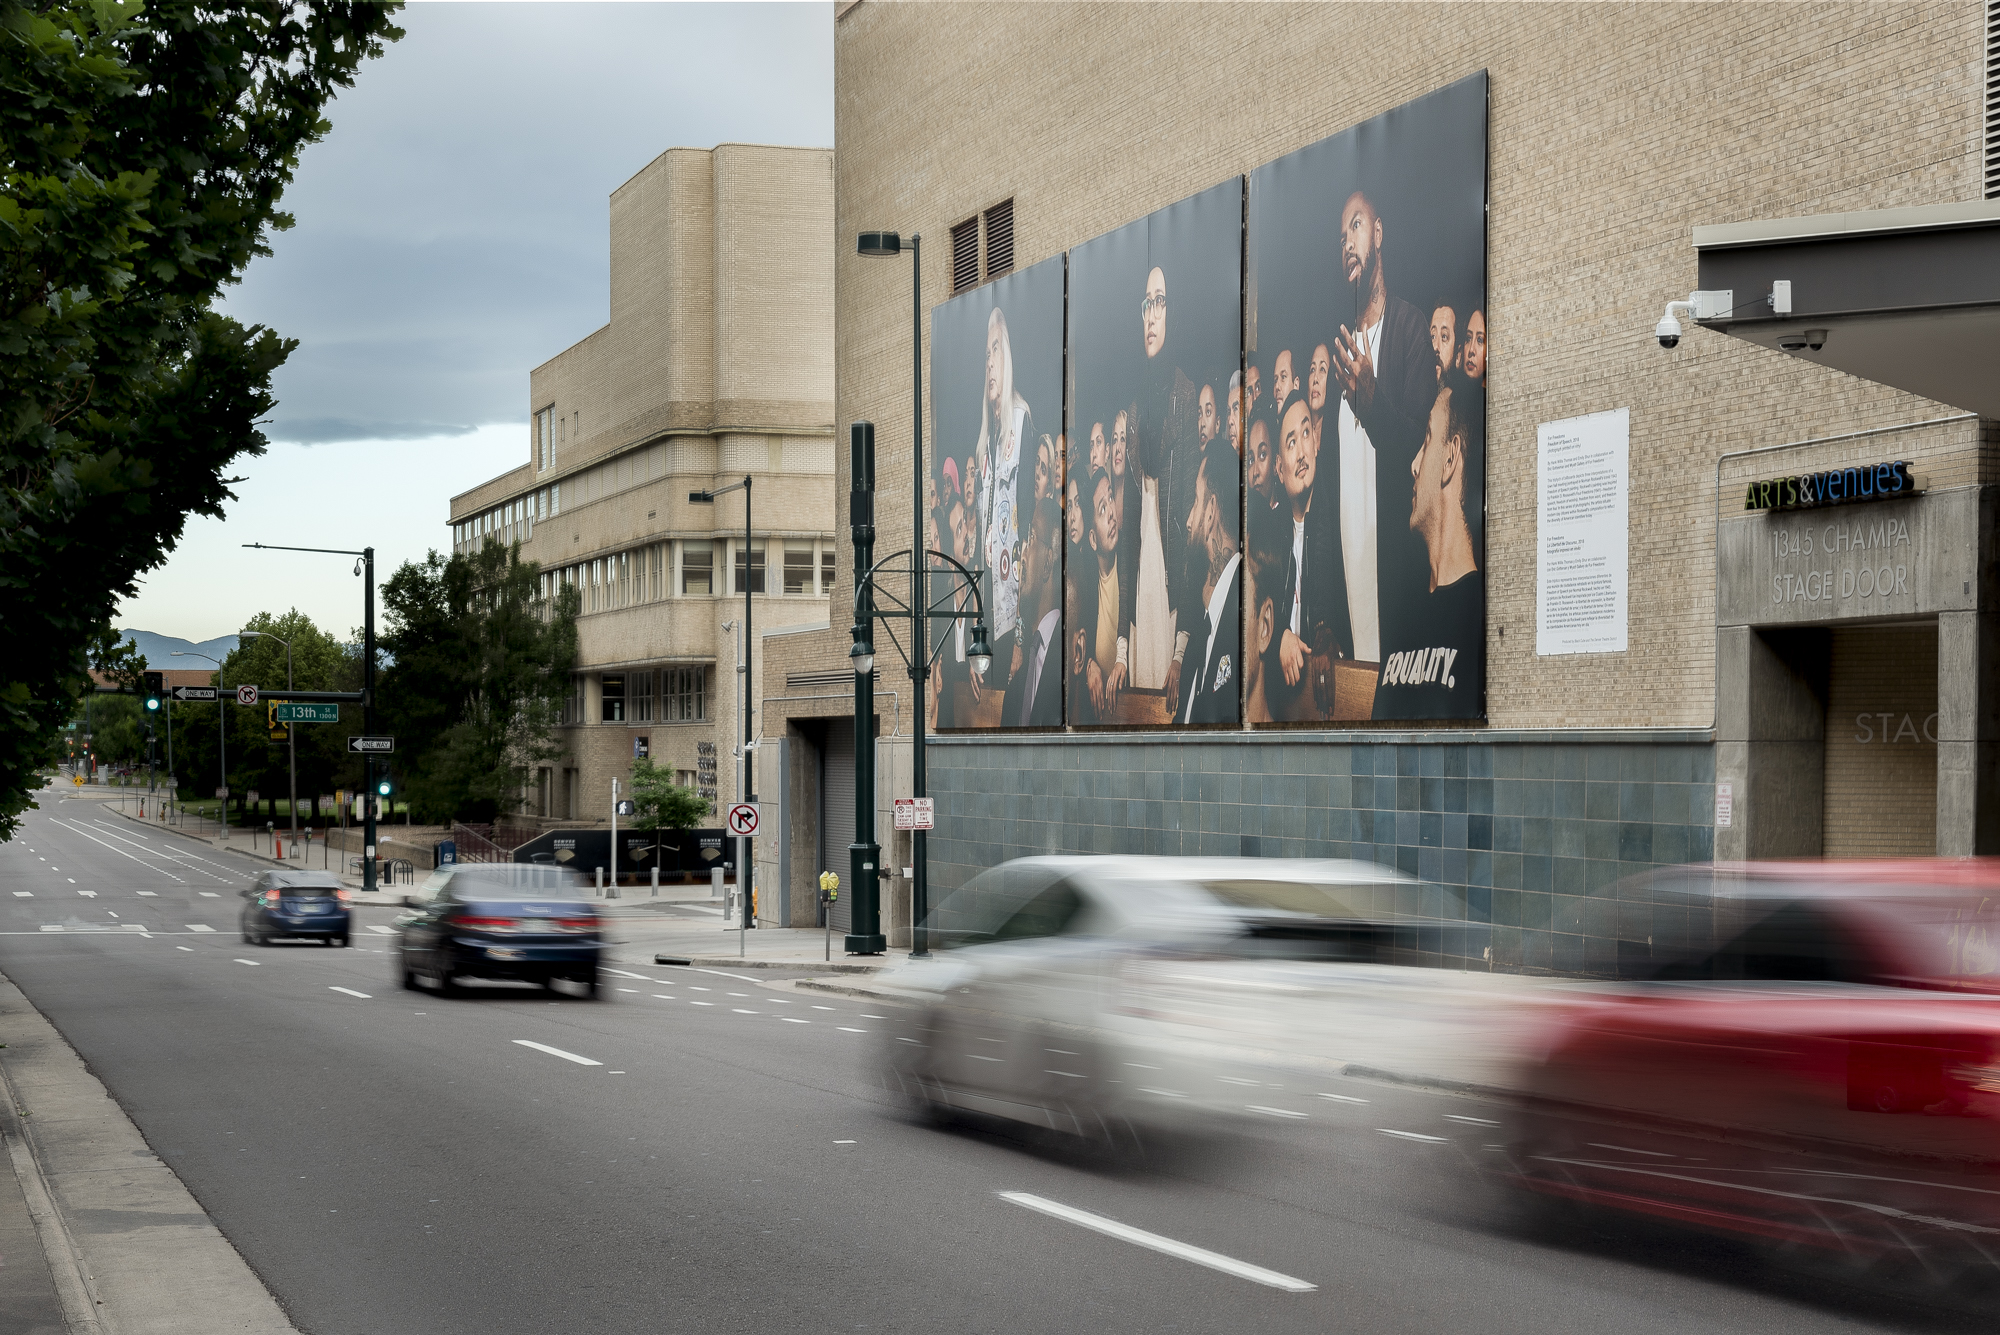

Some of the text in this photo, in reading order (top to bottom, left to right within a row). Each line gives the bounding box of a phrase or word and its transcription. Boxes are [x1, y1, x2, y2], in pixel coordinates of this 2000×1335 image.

[1773, 515, 1911, 558] 1345 CHAMPA
[1772, 564, 1909, 604] STAGE DOOR
[1381, 646, 1458, 688] EQUALITY.
[291, 706, 317, 718] 13th
